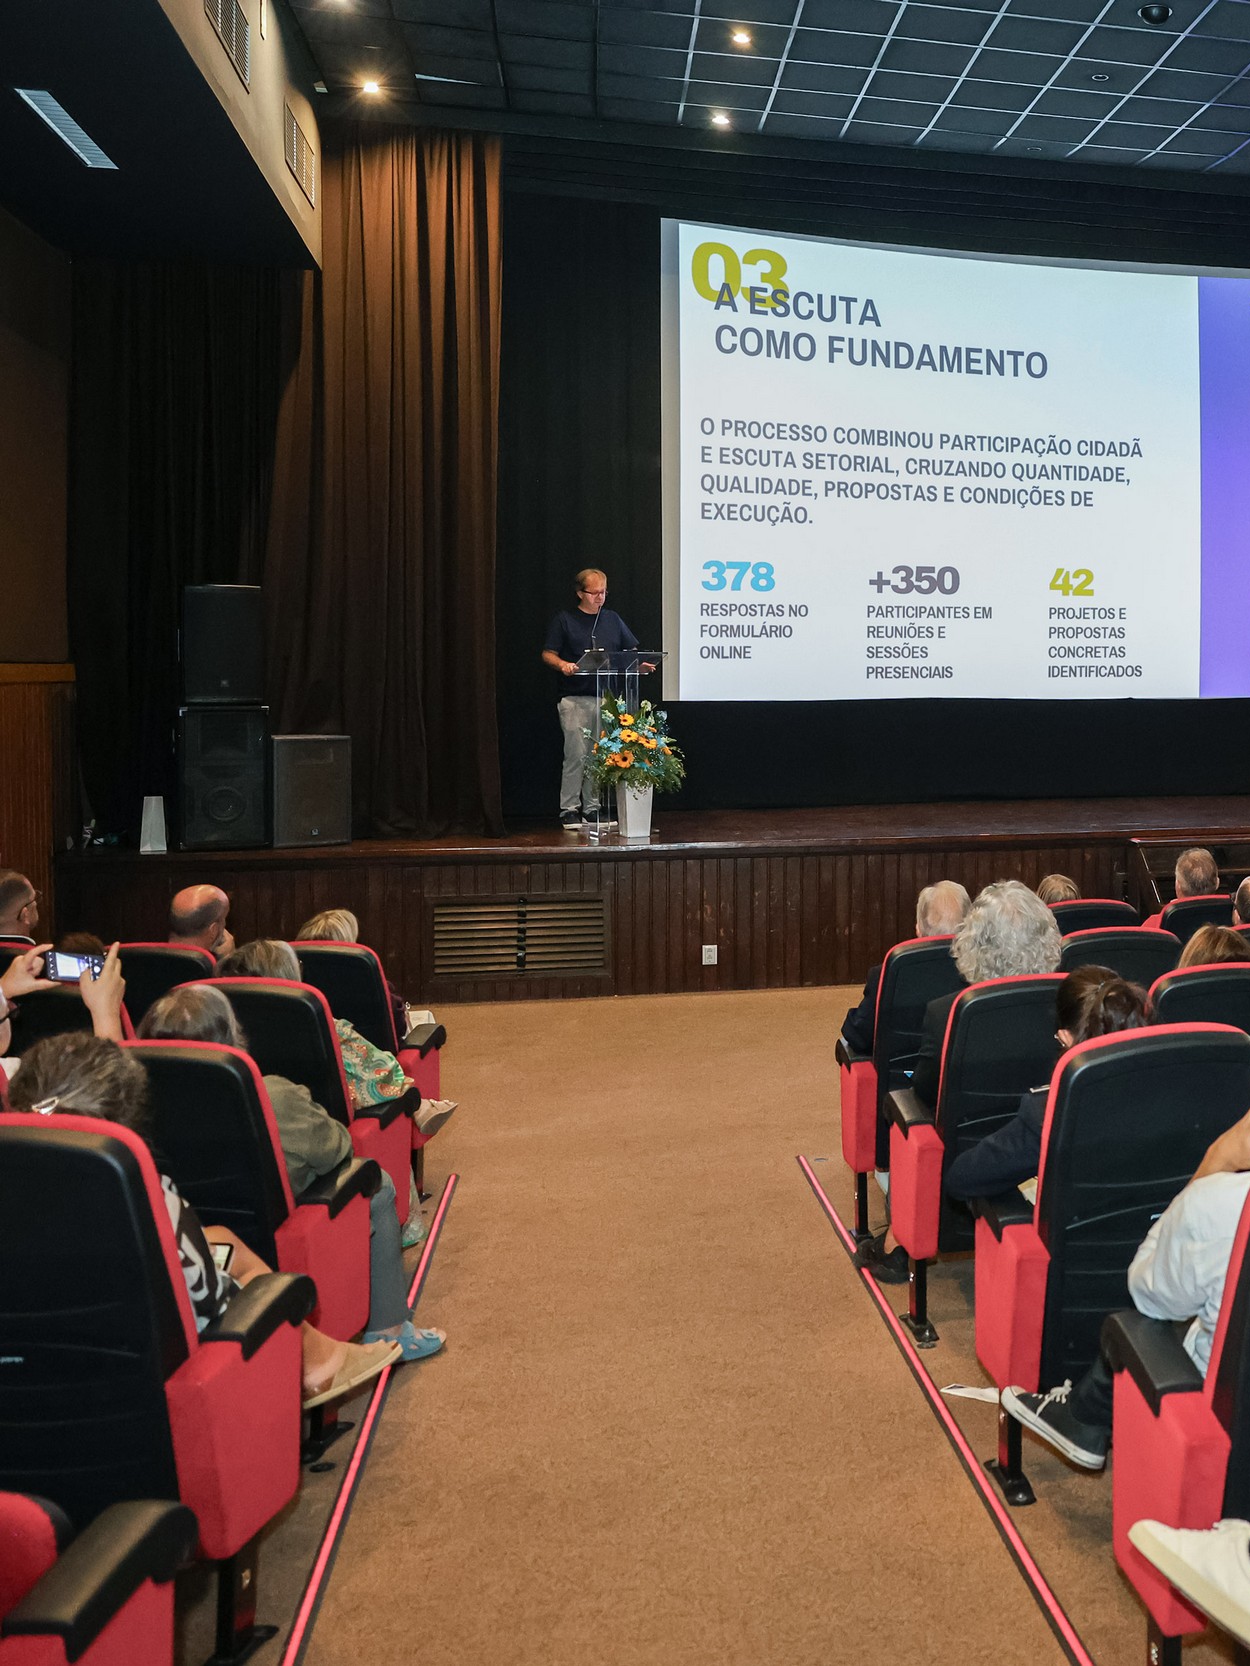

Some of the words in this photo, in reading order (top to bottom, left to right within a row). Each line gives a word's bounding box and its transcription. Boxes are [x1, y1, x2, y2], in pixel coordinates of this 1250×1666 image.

[691, 242, 790, 310] 03
[714, 283, 739, 313] A
[749, 286, 881, 327] ESCUTA
[715, 325, 817, 361] COMO
[828, 336, 1048, 379] FUNDAMENTO
[701, 417, 715, 436] O
[721, 419, 828, 443] PROCESSO
[833, 427, 934, 450] COMBINOU
[940, 433, 1072, 458] PARTICIPAÇÃO
[1077, 438, 1142, 458] CIDADÃ
[701, 446, 712, 463] E
[719, 448, 797, 469] ESCUTA
[802, 452, 900, 477] SETORIAL,
[905, 458, 1006, 479] CRUZANDO
[1011, 463, 1131, 487] QUANTIDADE,
[701, 474, 818, 499] QUALIDADE,
[824, 481, 938, 502] PROPOSTAS
[944, 486, 955, 503] E
[960, 485, 1065, 508] CONDIÇÕES
[1071, 491, 1094, 507] DE
[701, 502, 813, 526] EXECUÇÃO.
[701, 560, 776, 592] 378
[869, 565, 960, 595] +350
[1049, 568, 1095, 597] 42
[700, 603, 784, 618] RESPOSTAS
[789, 604, 809, 618] NO
[867, 606, 969, 620] PARTICIPANTES
[974, 606, 992, 619] EM
[1049, 607, 1115, 620] PROJETOS
[1119, 608, 1126, 620] E
[700, 621, 793, 639] FORMULÁRIO
[867, 624, 934, 640] REUNIÕES
[938, 626, 946, 639] E
[1049, 626, 1125, 640] PROPOSTAS
[700, 645, 752, 659] ONLINE
[866, 643, 928, 659] SESSÕES
[1048, 645, 1126, 659] CONCRETAS
[866, 665, 953, 679] PRESENCIAIS
[1048, 665, 1142, 678] IDENTIFICADOS
